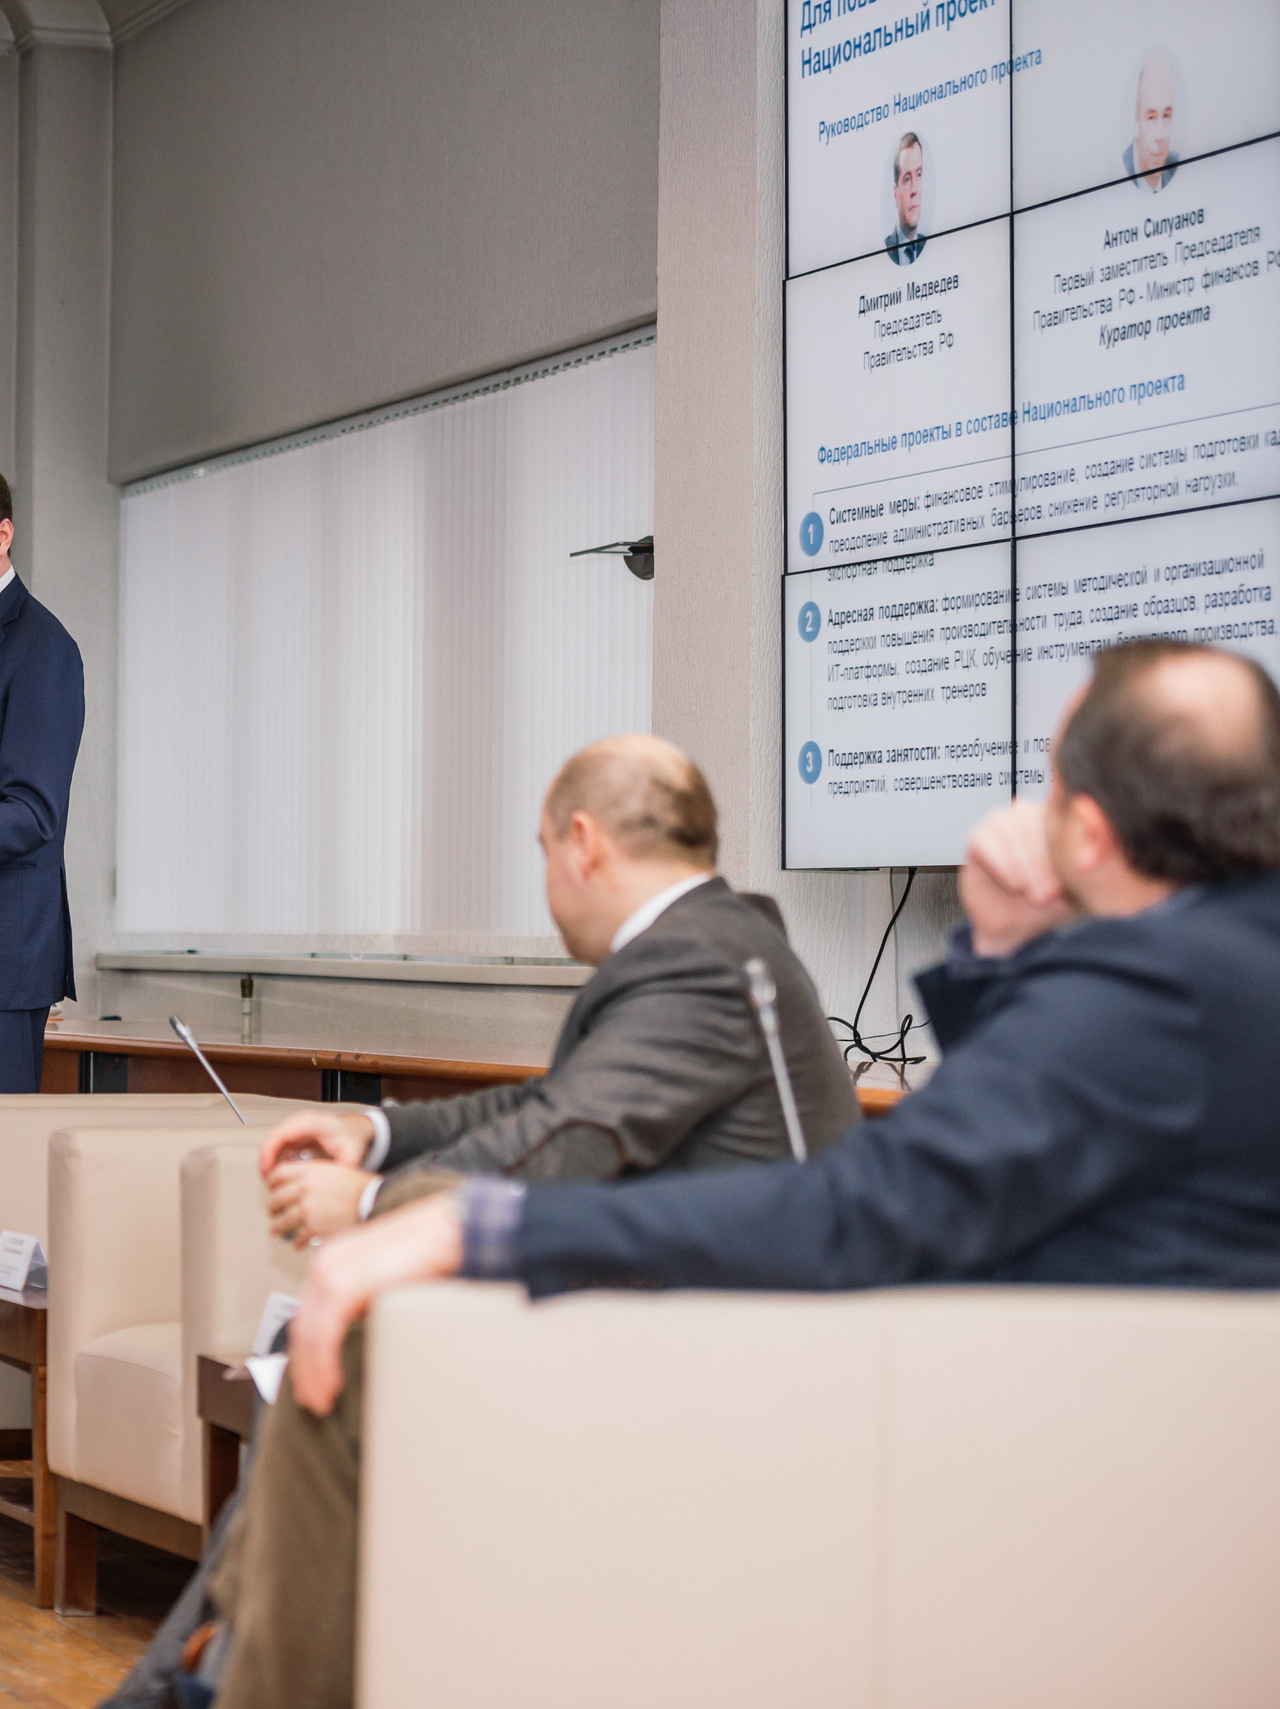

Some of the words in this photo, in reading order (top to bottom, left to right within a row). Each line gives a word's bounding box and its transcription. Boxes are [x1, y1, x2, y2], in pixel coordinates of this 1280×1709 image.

[800, 0, 831, 38] Для
[801, 2, 930, 79] Национальный
[935, 0, 996, 31] прое
[819, 103, 890, 145] Руководство
[893, 67, 988, 115] Национального
[991, 46, 1042, 84] проекта
[1103, 226, 1138, 251] Антон
[1143, 207, 1205, 239] Силуанов
[1053, 266, 1095, 297] Первый
[1099, 250, 1169, 283] заместитель
[1174, 224, 1262, 264] Председателя
[858, 287, 902, 318] Дмитрий
[907, 274, 959, 302] Медведев
[1032, 296, 1113, 333] Правительства
[1119, 285, 1136, 310] РФ
[1146, 275, 1195, 303] Министр
[1200, 259, 1260, 293] финансов
[874, 309, 942, 342] Председатель
[1099, 317, 1152, 351] Куратор
[1156, 304, 1211, 337] проекта
[863, 340, 934, 374] Правительства
[939, 332, 955, 352] РФ
[817, 434, 899, 467] Федеральные
[900, 423, 953, 454] проекты
[955, 421, 963, 438] в
[966, 407, 1019, 436] составе
[1022, 386, 1126, 425] Национального
[1129, 373, 1187, 407] проекта
[828, 502, 885, 526] Системные
[888, 494, 921, 518] меры:
[923, 483, 984, 512] финансовое
[1084, 455, 1135, 481] создание
[1138, 446, 1188, 471] системы
[1192, 432, 1260, 462] подготовки
[828, 528, 888, 554] преодоление
[892, 514, 986, 545] административных
[1048, 493, 1099, 519] снижение
[1103, 477, 1180, 513] регуляторной
[826, 560, 878, 583] экспортная
[881, 552, 935, 576] поддержка
[827, 605, 875, 630] Адресная
[878, 598, 939, 622] поддержка:
[941, 587, 1021, 613] формирование
[1025, 579, 1069, 602] системы
[1073, 565, 1148, 595] методической
[1153, 567, 1161, 584] и
[1163, 548, 1265, 585] организационной
[805, 610, 814, 632] 2
[827, 633, 877, 656] поддержки
[880, 626, 935, 650] повышения
[1089, 600, 1139, 625] создание
[1203, 583, 1272, 615] разработка
[904, 654, 950, 675] создание
[982, 645, 1033, 670] обучение
[827, 691, 878, 713] подготовка
[881, 687, 935, 710] внутренних
[940, 680, 988, 704] тренеров
[805, 751, 814, 773] 3
[827, 748, 883, 770] Поддержка
[885, 744, 941, 764] занятости:
[1023, 739, 1030, 754] и
[893, 770, 993, 794] совершенствование
